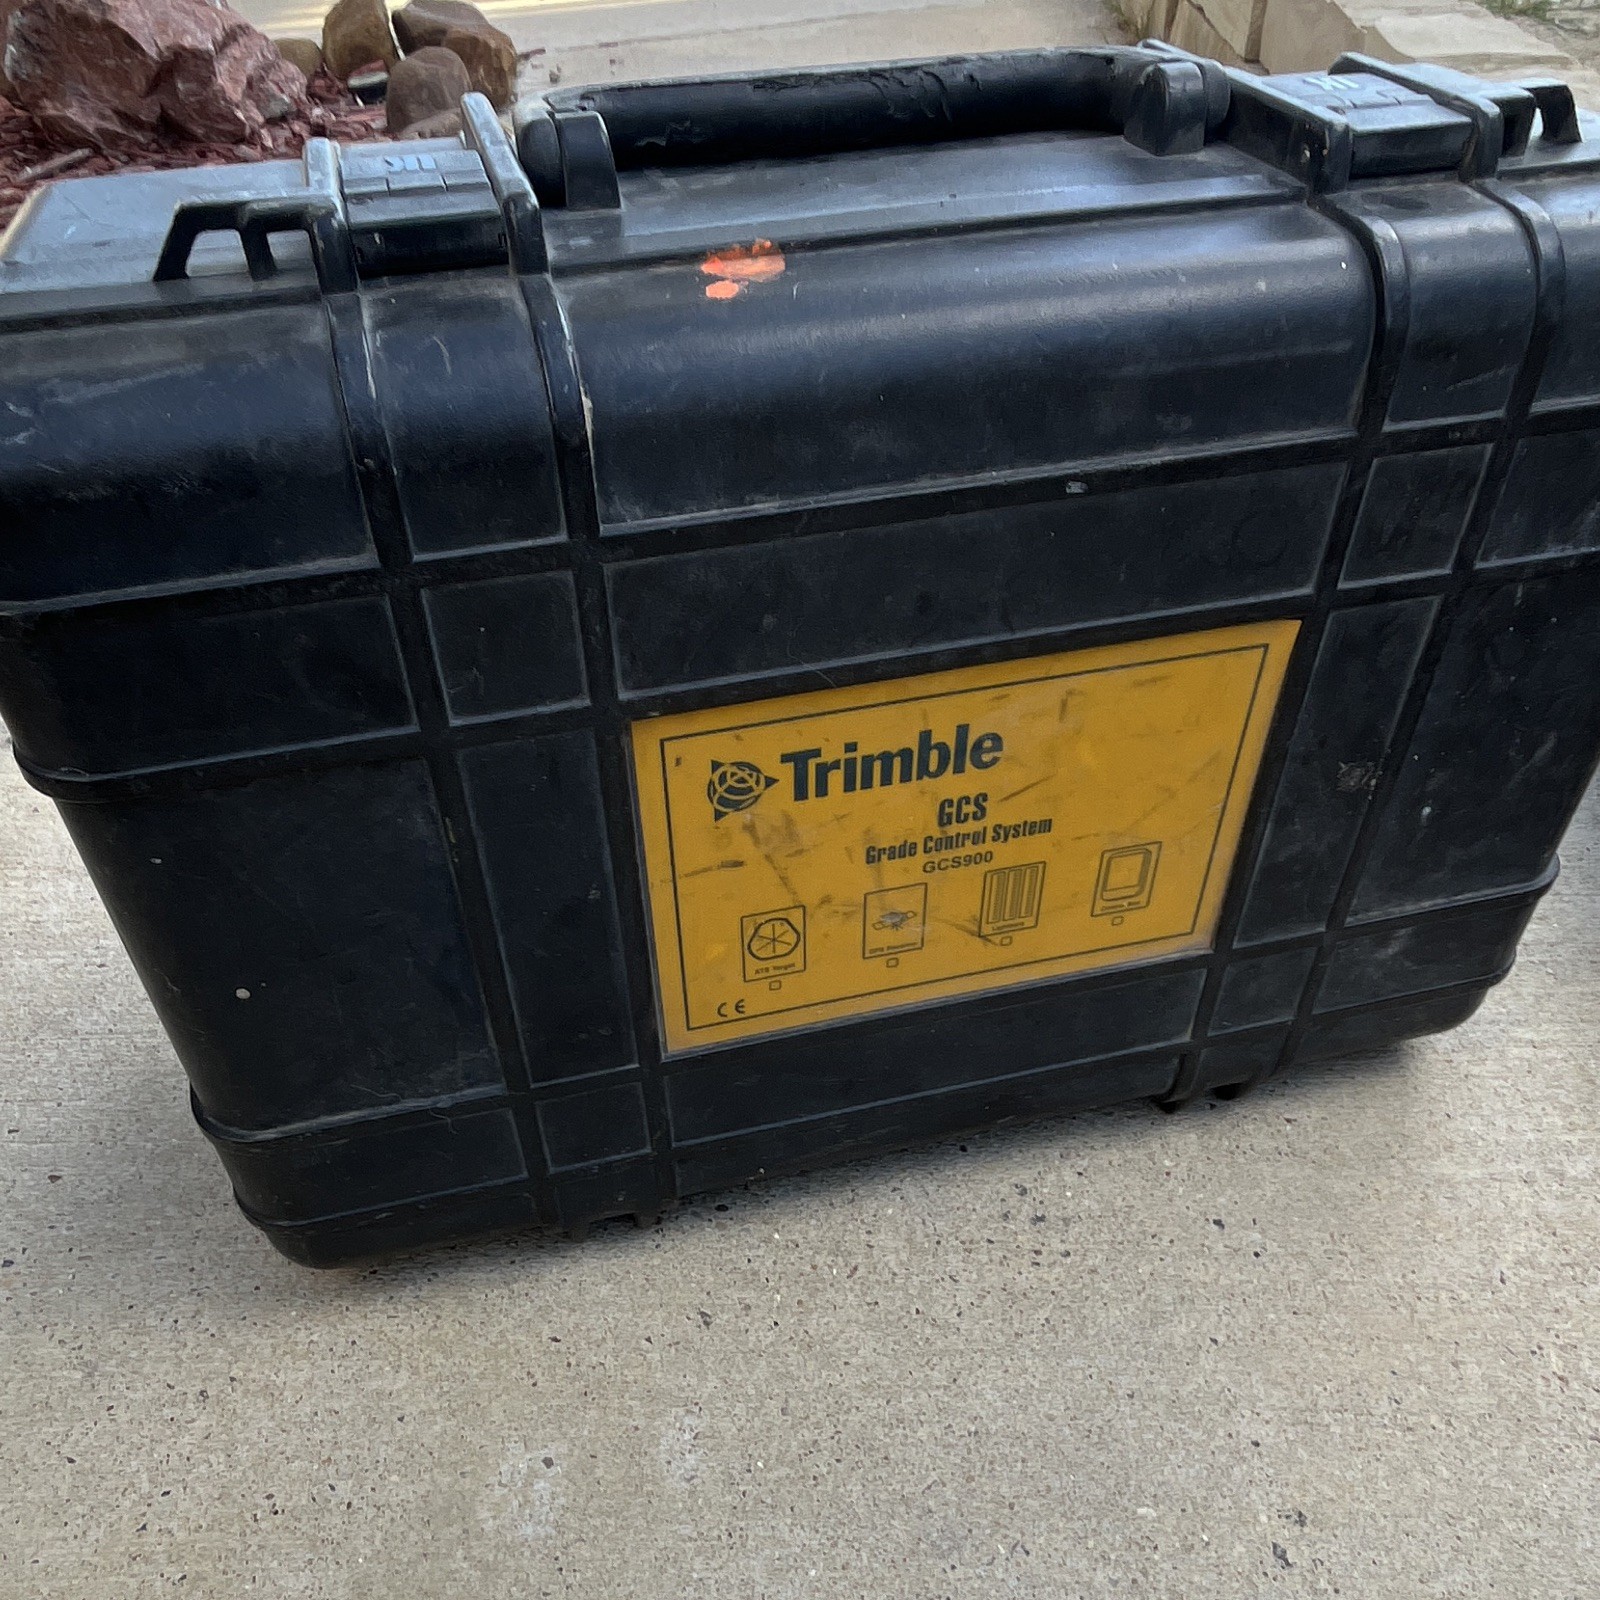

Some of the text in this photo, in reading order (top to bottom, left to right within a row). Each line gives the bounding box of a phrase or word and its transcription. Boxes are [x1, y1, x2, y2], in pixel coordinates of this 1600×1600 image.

[780, 723, 1004, 802] Trimble
[938, 792, 988, 828] GCS
[865, 818, 1053, 865] Grade Control System
[922, 850, 994, 874] GCS900
